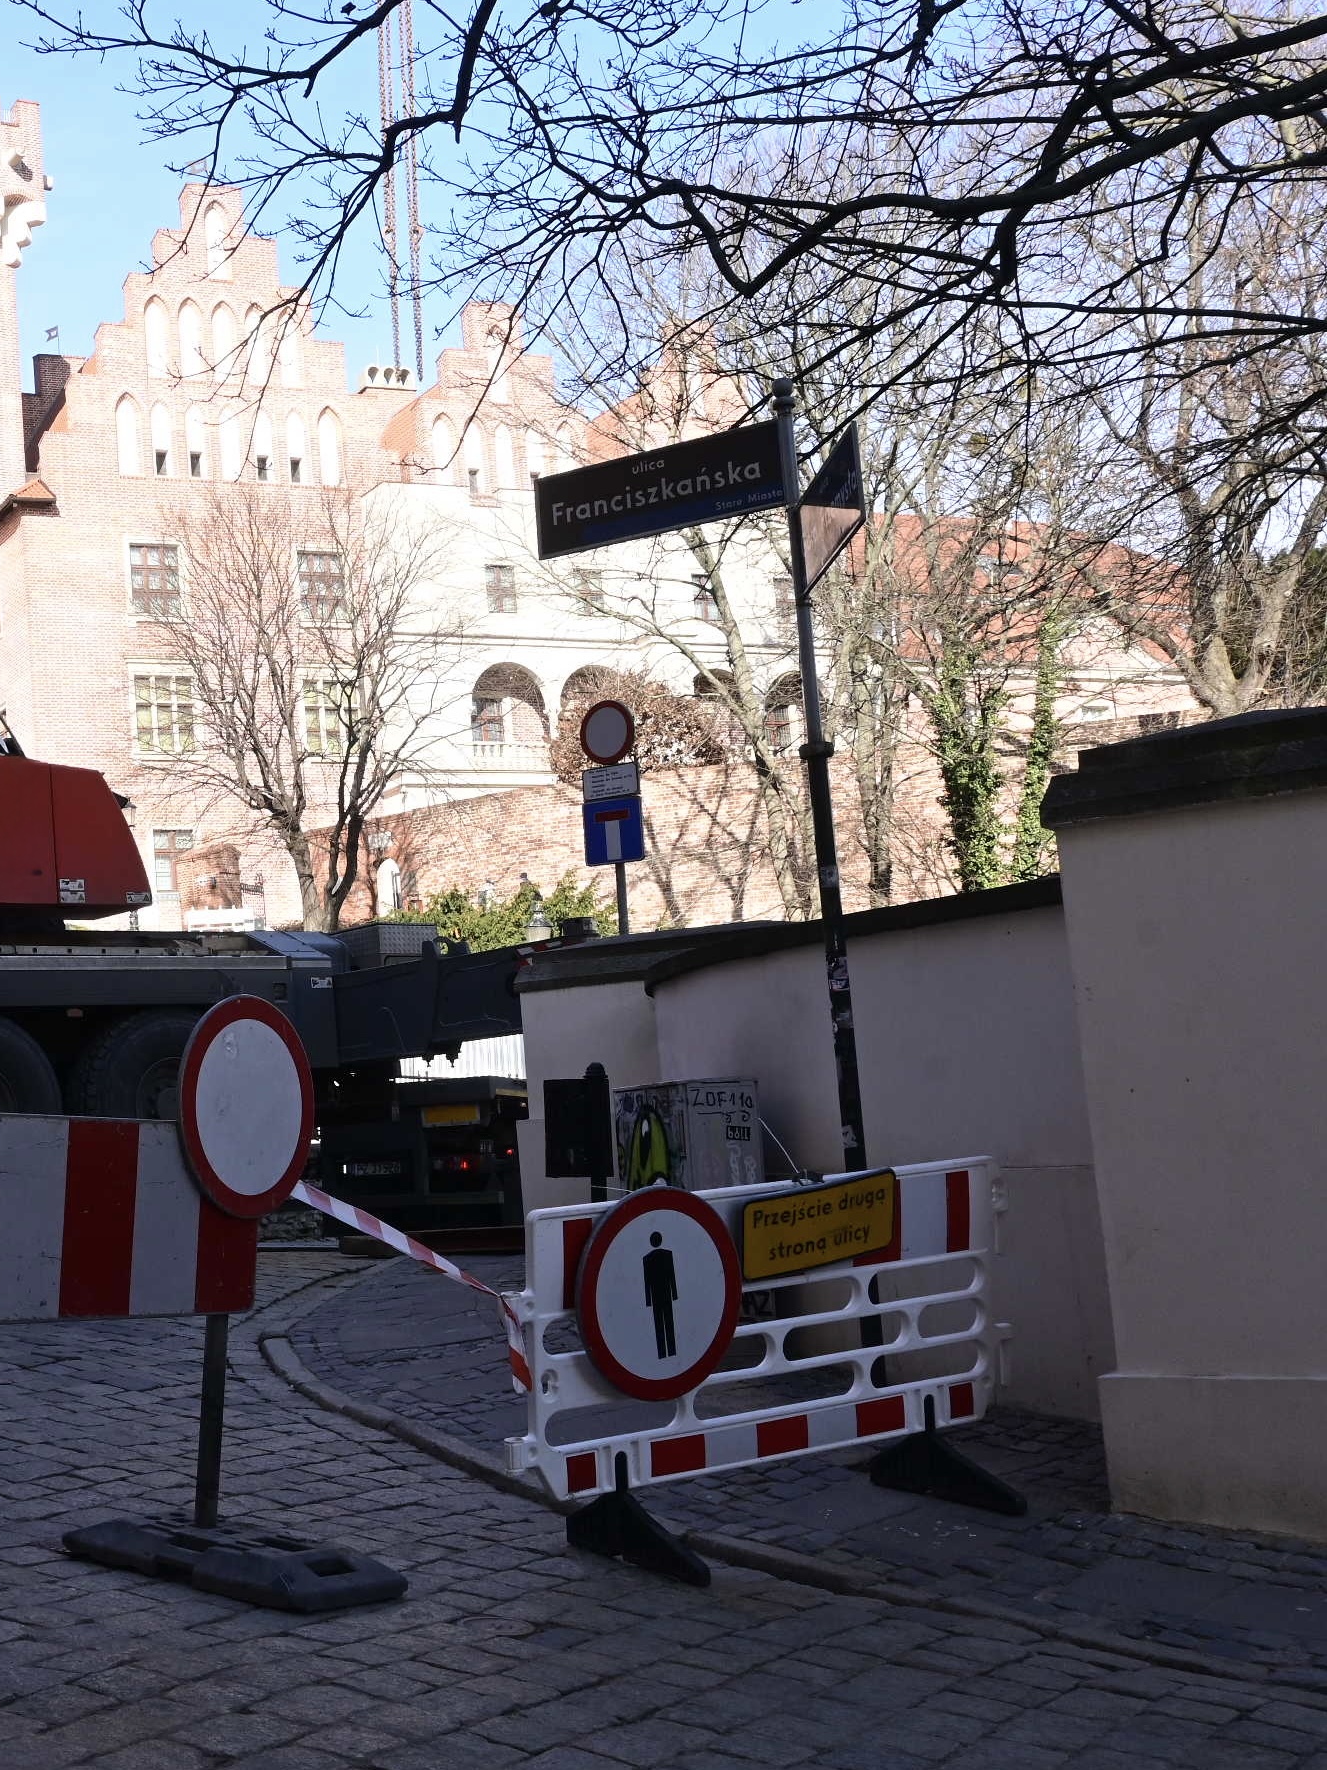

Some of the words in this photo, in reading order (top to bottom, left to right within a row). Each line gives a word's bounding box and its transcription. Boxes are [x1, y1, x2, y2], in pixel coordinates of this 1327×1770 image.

[631, 459, 665, 475] ulica
[552, 460, 761, 526] Franciszkańska
[753, 1201, 832, 1229] Przejście
[839, 1188, 886, 1212] drugą
[769, 1235, 827, 1262] stroną
[834, 1224, 871, 1247] ulicy
